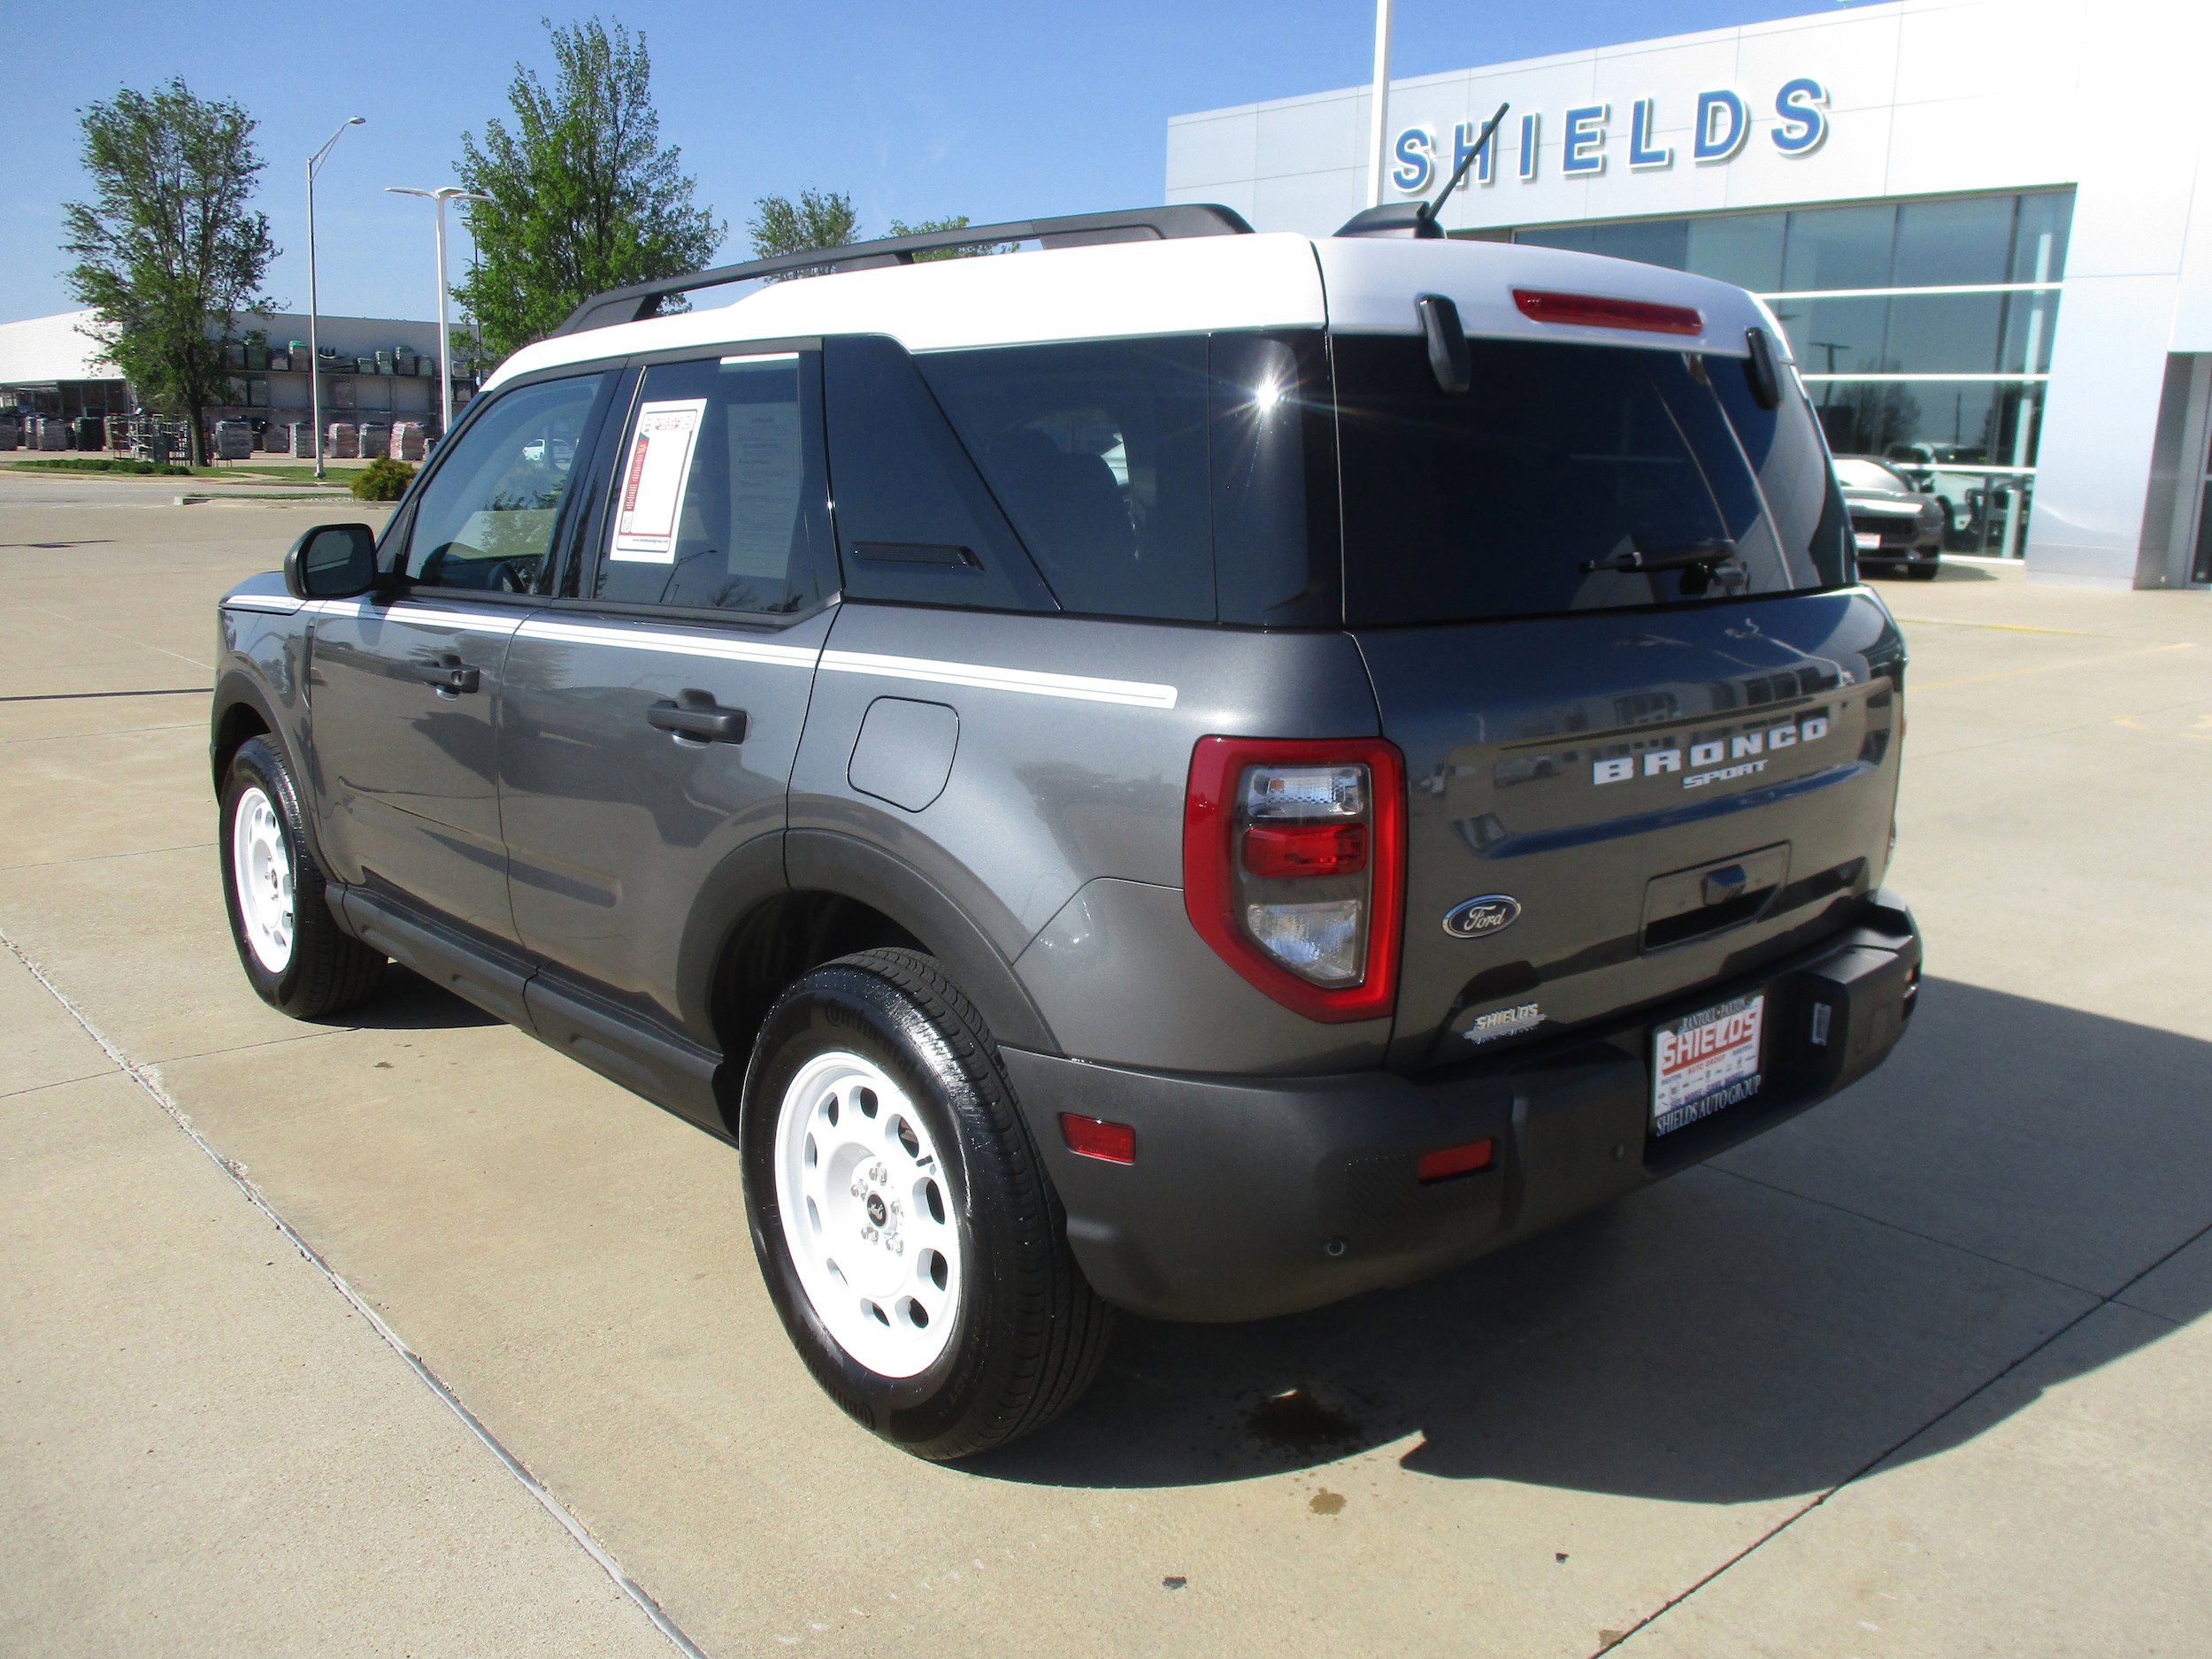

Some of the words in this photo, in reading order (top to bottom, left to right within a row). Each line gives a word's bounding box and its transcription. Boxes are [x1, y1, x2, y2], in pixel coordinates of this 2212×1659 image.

[1391, 77, 1830, 193] SHIELDS
[1594, 717, 1828, 785] BRONCO
[1682, 759, 1769, 788] SPORT
[1463, 905, 1507, 931] Ford
[1477, 1003, 1539, 1030] SHIELDS
[1663, 1011, 1757, 1068] SHIELDS
[1656, 1100, 1699, 1137] SHIELDS
[1699, 1089, 1726, 1118] AUTO
[1728, 1074, 1762, 1105] GROUP
